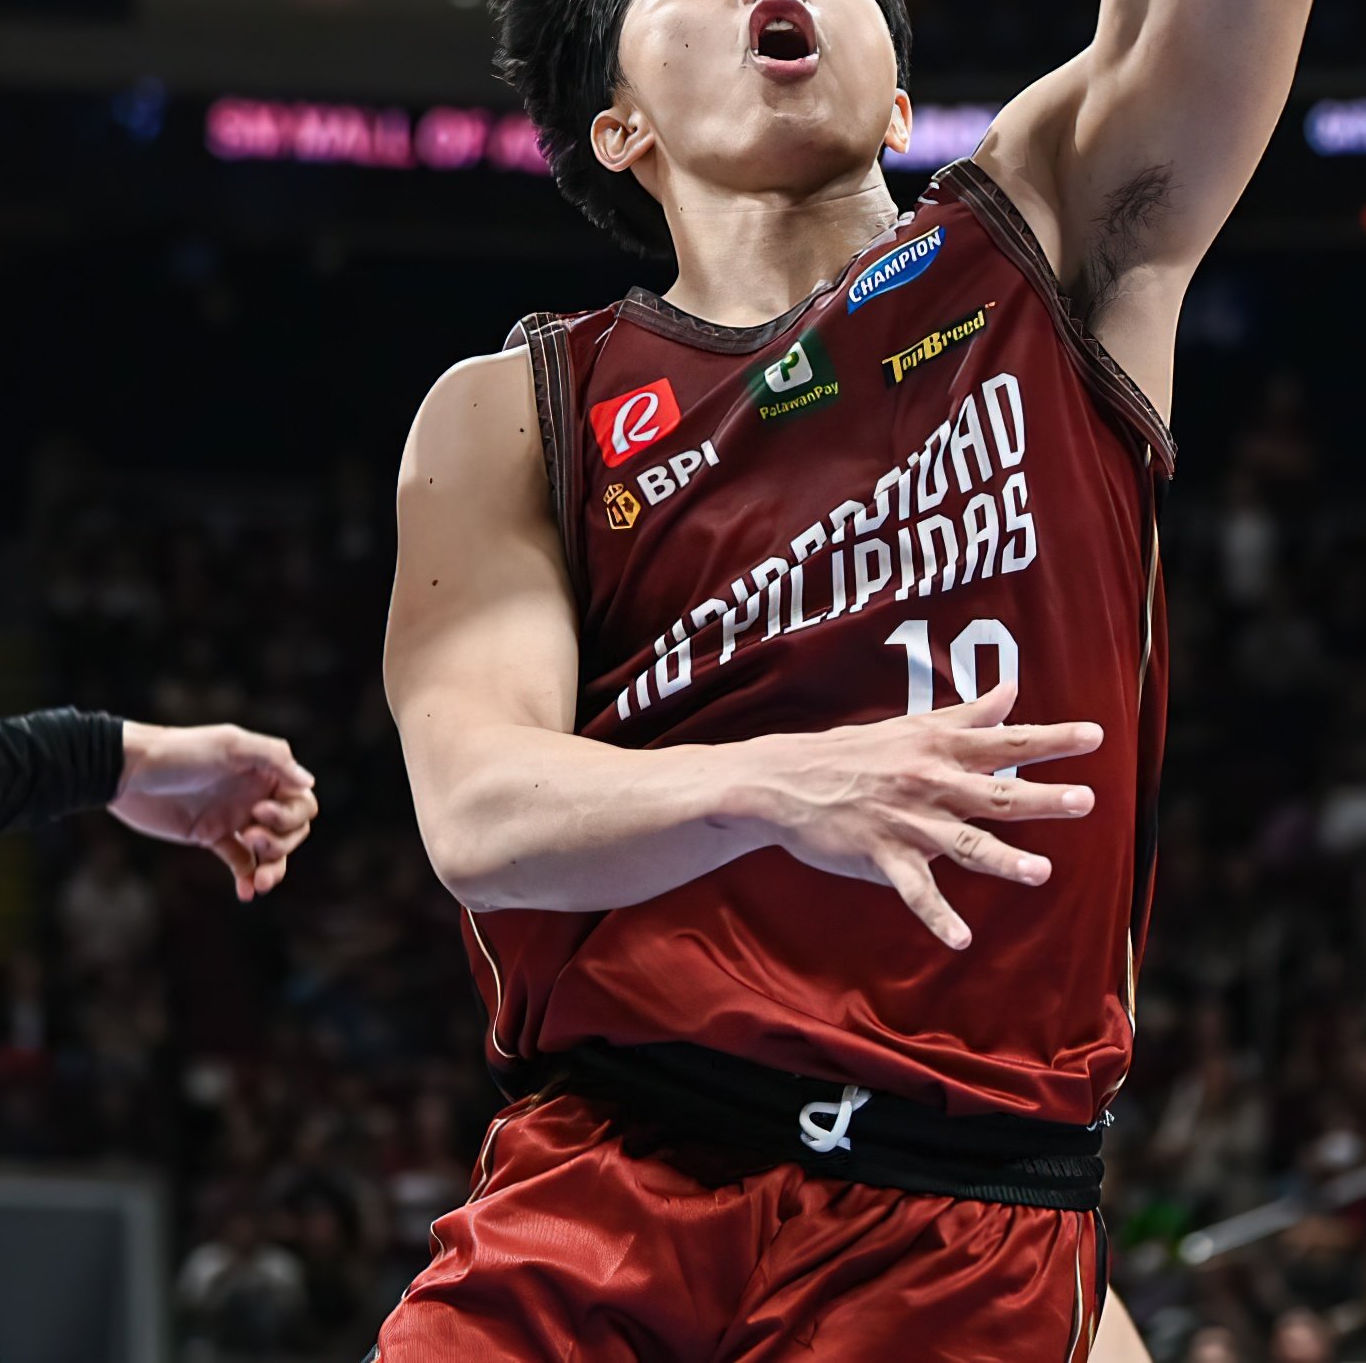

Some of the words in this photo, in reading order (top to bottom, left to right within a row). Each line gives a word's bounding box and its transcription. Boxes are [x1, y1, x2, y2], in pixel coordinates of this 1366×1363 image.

[848, 231, 942, 303] CHAMPION
[759, 381, 839, 420] PalawanPay
[636, 439, 721, 507] BPI
